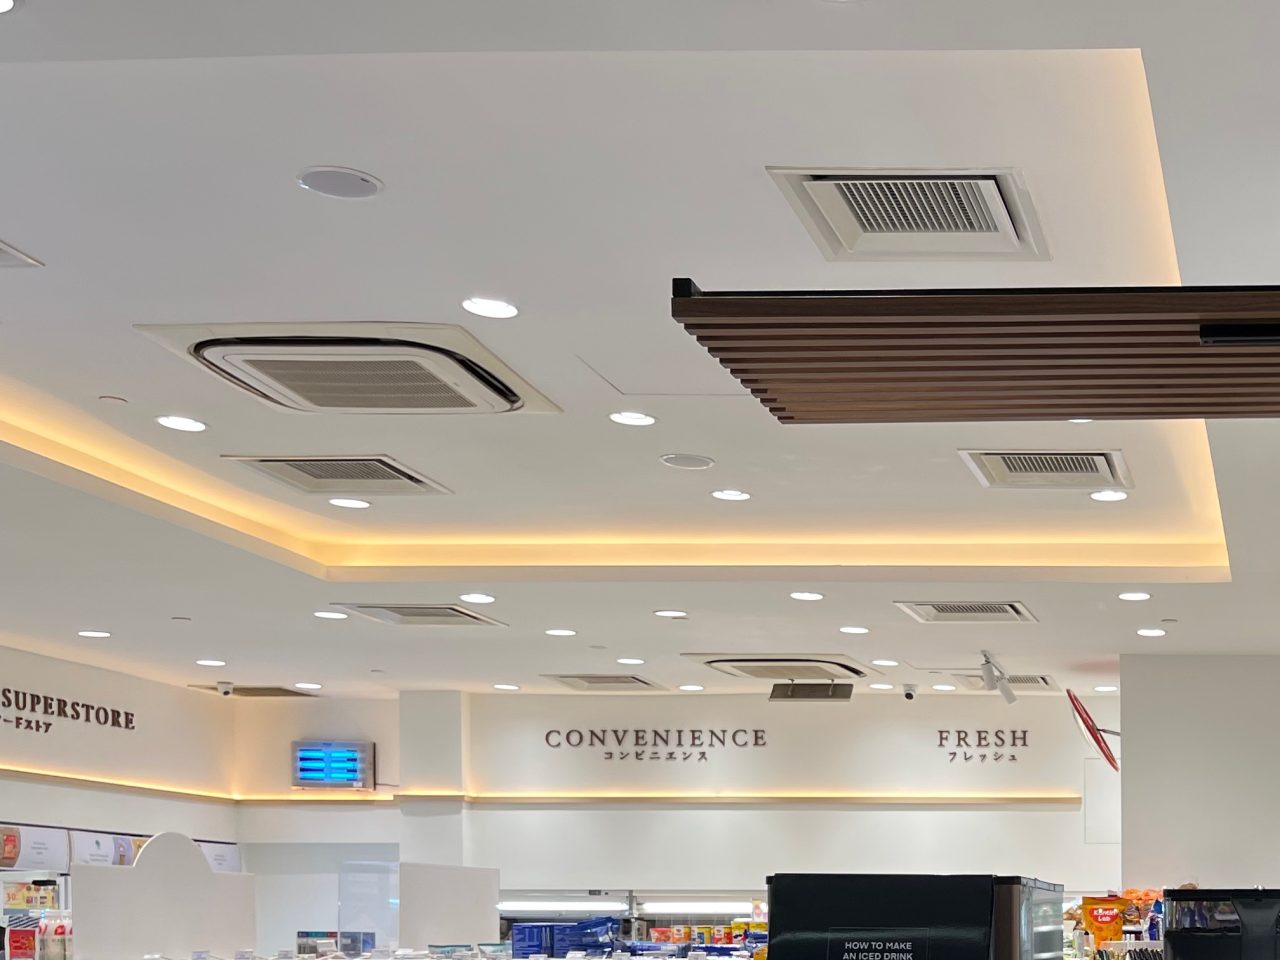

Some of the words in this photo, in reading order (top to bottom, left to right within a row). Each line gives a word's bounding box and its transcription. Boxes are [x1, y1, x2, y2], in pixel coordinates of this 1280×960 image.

[1, 688, 135, 730] SUPERSTORE
[545, 730, 767, 748] CONVENIENCE
[937, 730, 1029, 747] FRESH
[604, 751, 708, 762] コンビニエンス
[948, 752, 1018, 763] フレッシュ
[845, 942, 869, 950] HOW
[871, 942, 883, 950] TO
[886, 942, 913, 950] MAKE
[883, 953, 913, 960] DRINK
